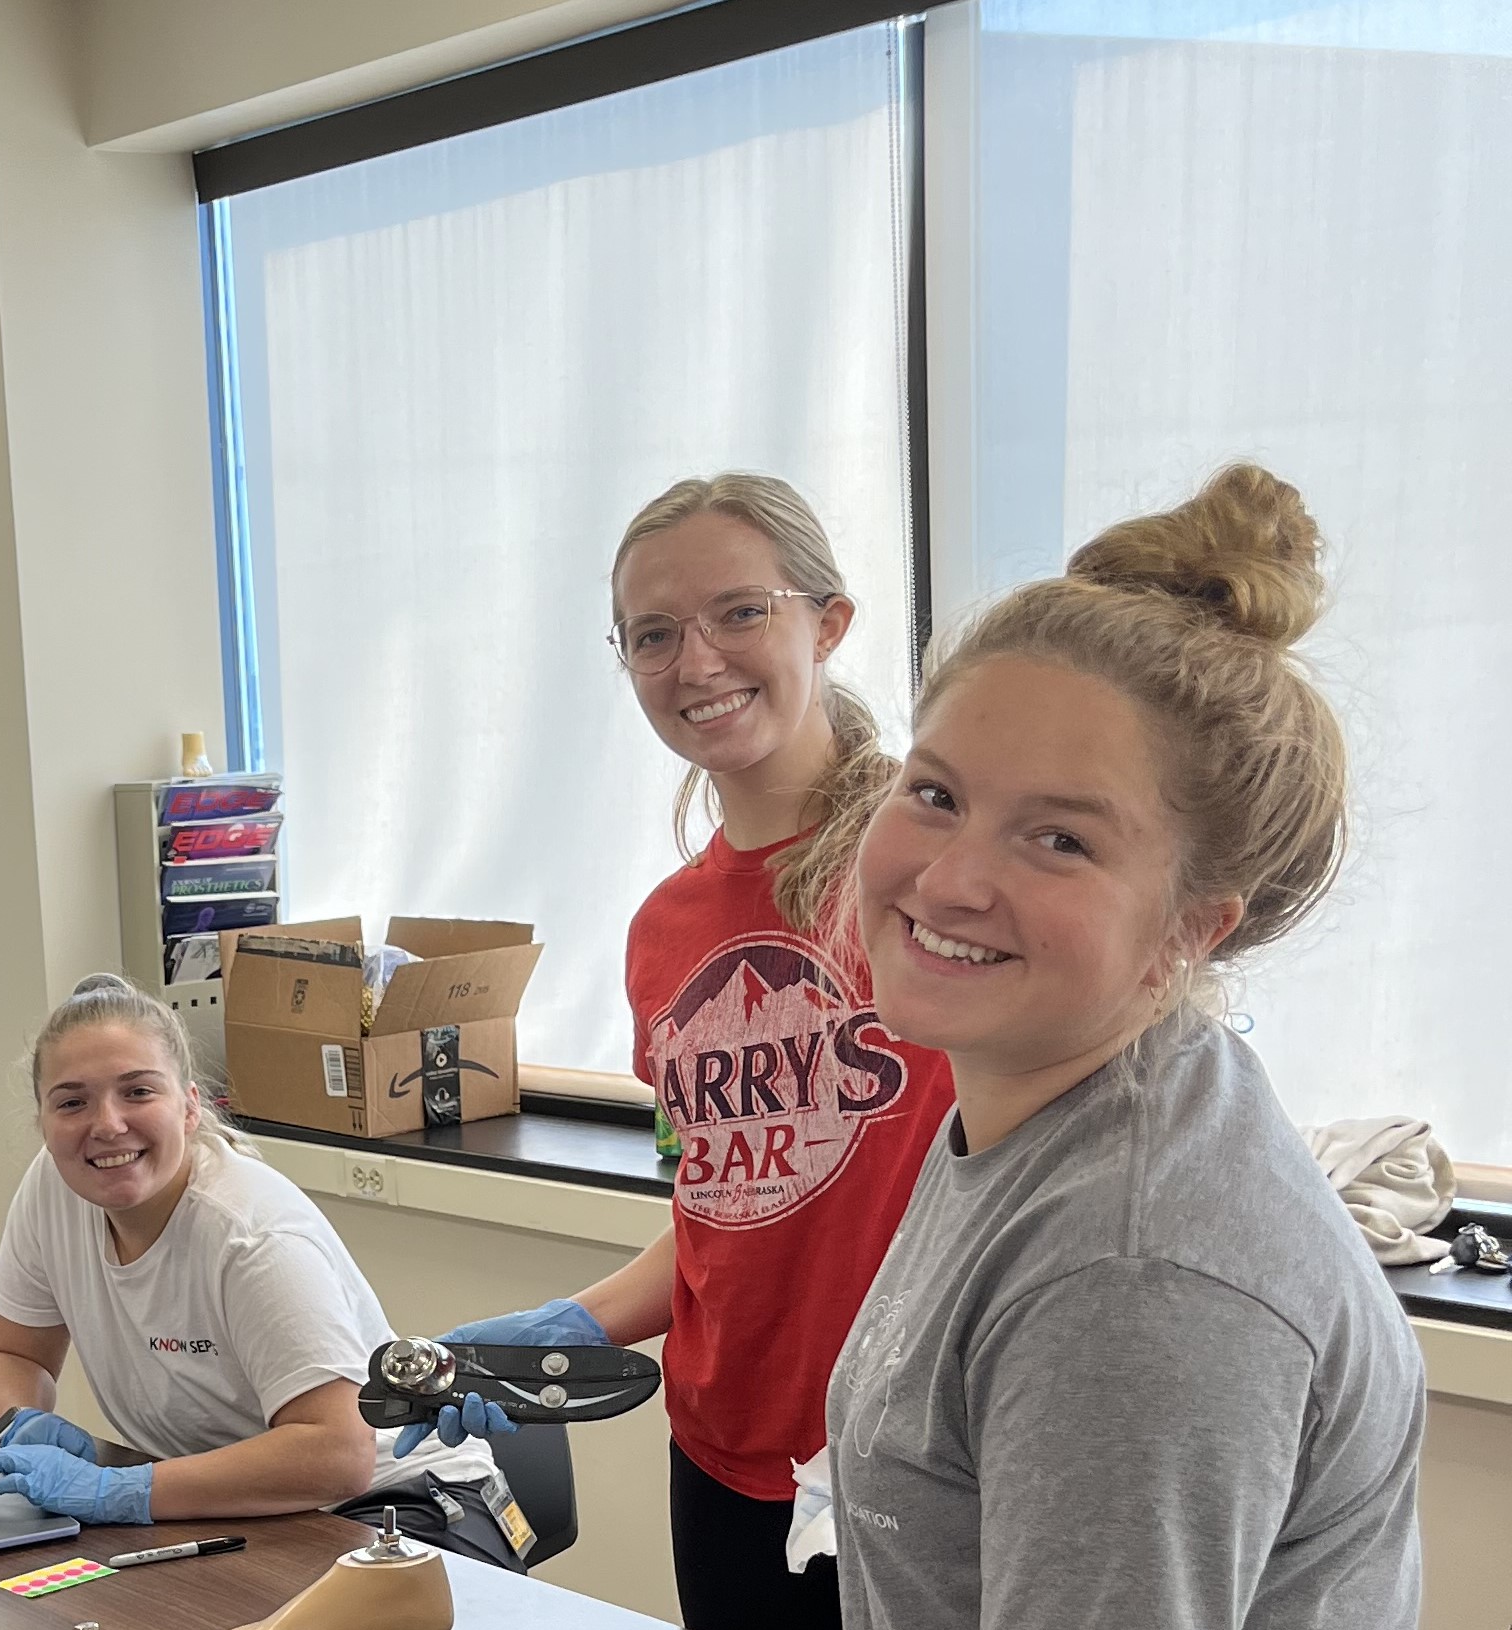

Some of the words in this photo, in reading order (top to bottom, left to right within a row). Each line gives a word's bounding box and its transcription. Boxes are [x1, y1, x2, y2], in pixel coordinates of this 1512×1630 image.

[172, 826, 275, 852] EDGE
[448, 982, 471, 999] 118
[648, 1012, 903, 1126] ARRY'S
[680, 1124, 798, 1185] BAR
[691, 1189, 732, 1200] LINCOLN
[149, 1337, 188, 1352] KNOW
